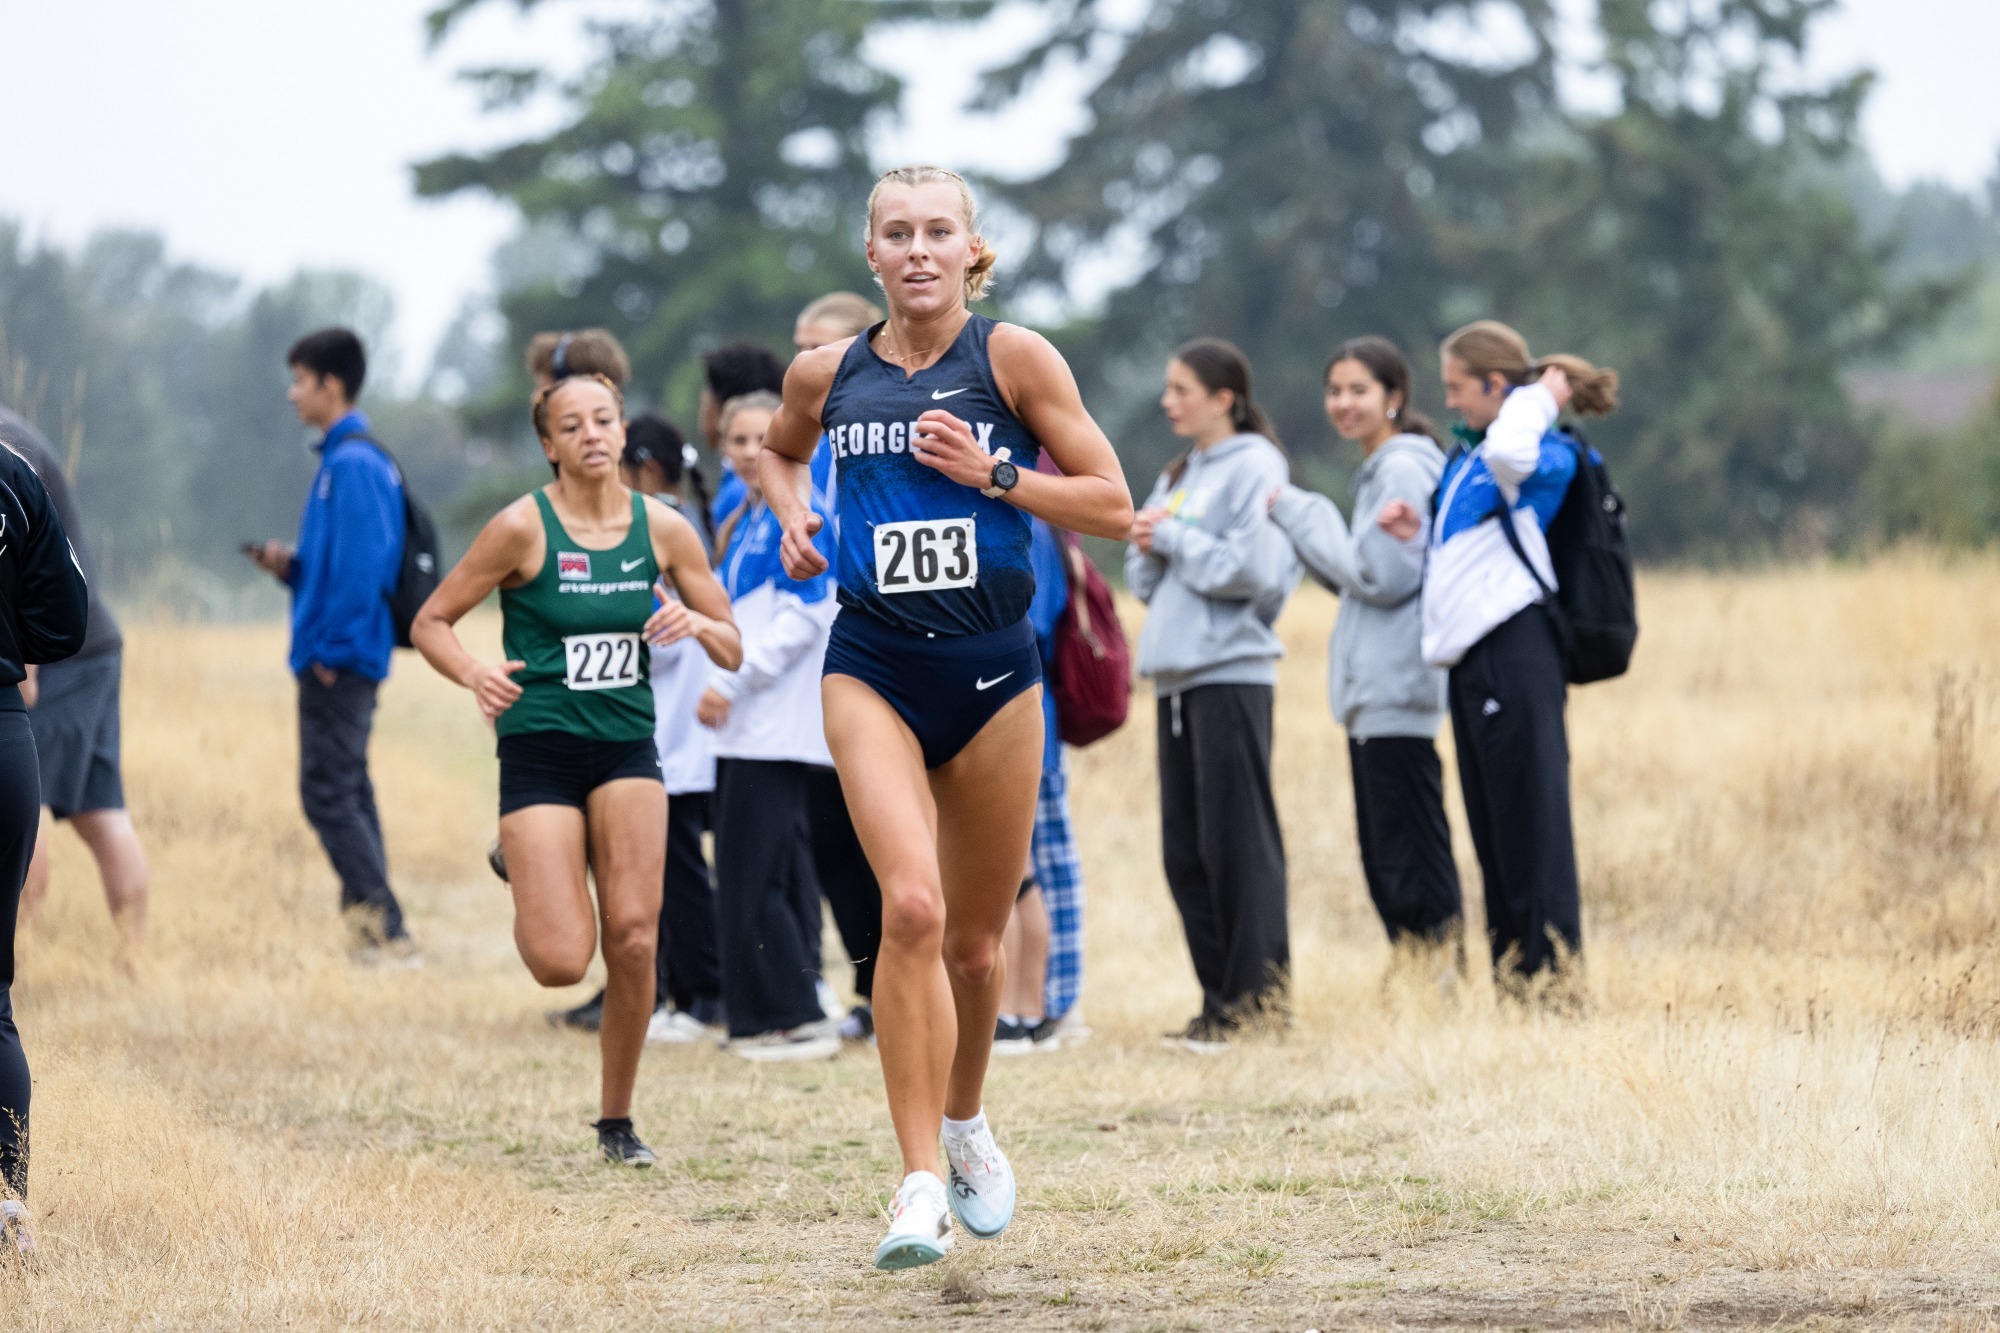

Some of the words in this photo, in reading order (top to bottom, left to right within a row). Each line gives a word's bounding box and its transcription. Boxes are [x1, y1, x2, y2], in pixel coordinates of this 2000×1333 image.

[882, 526, 969, 585] 263
[559, 580, 648, 595] evergreen
[573, 639, 633, 683] 222
